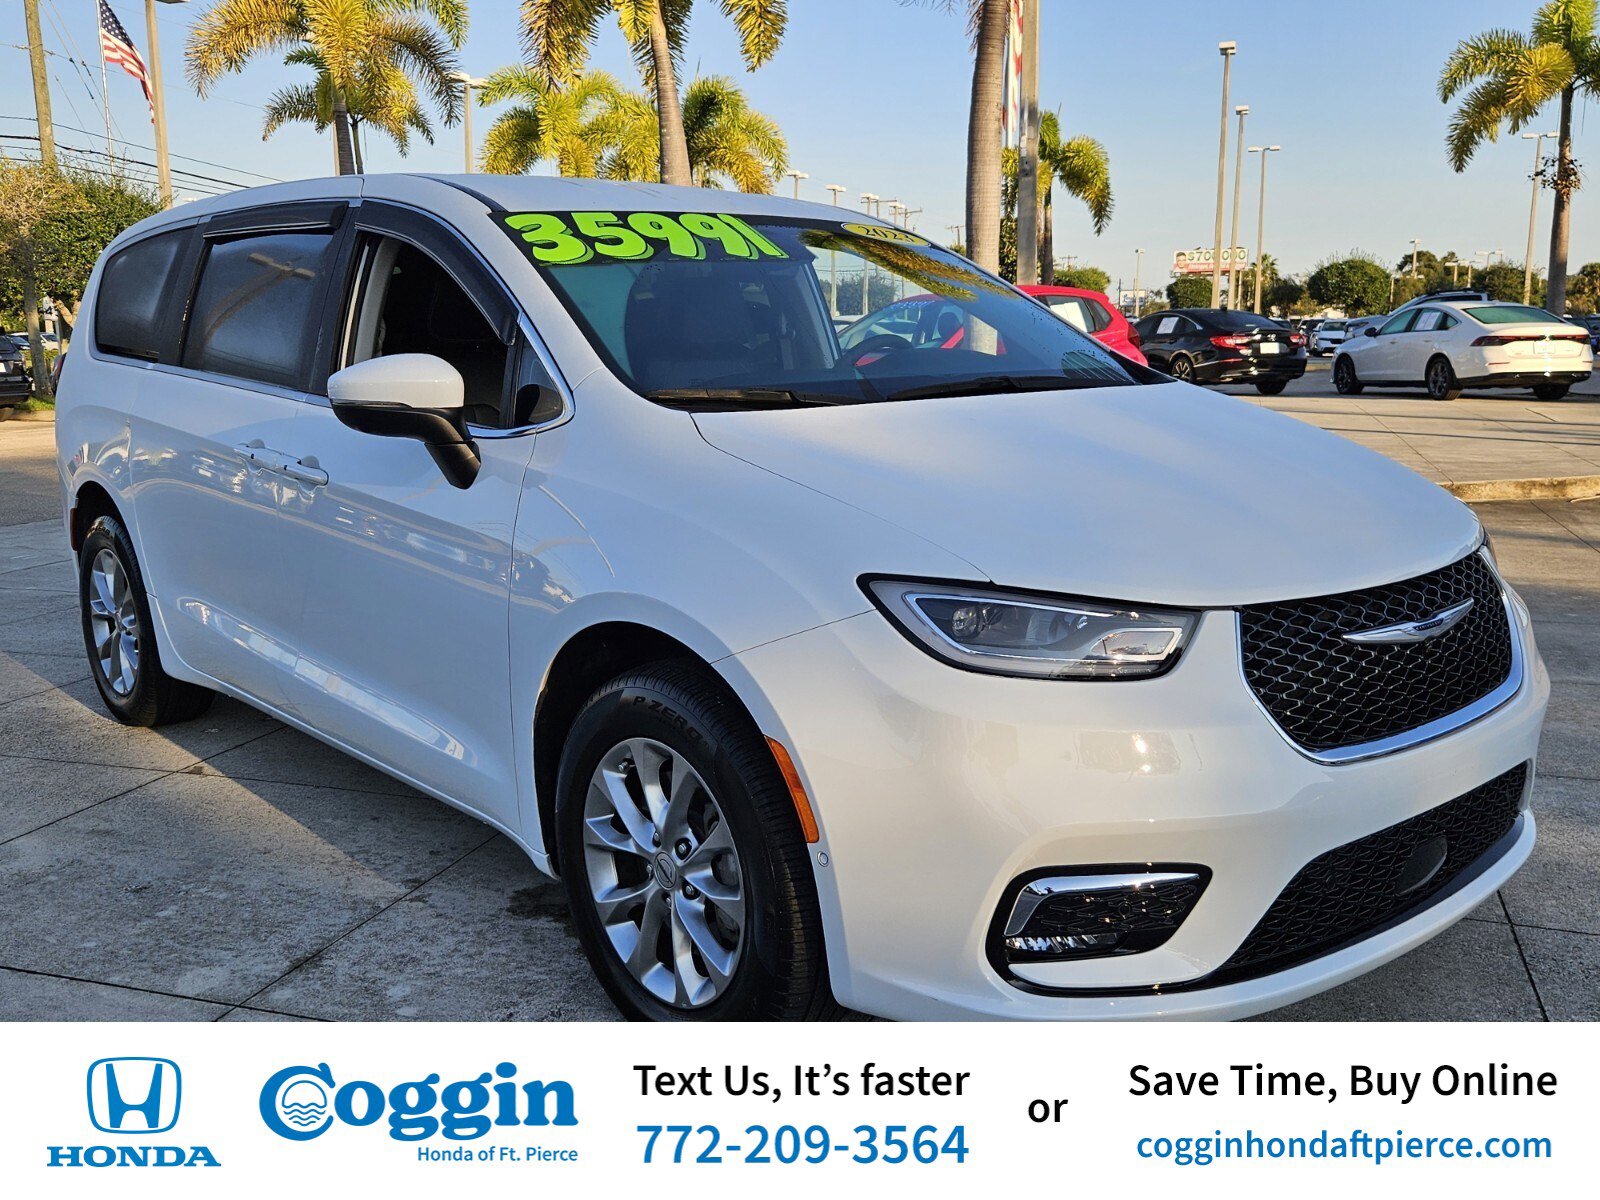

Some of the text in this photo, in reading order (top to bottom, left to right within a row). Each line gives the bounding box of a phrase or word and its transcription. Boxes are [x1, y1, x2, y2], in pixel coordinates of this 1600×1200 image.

[504, 212, 790, 265] 35991
[632, 695, 704, 740] P ZERO
